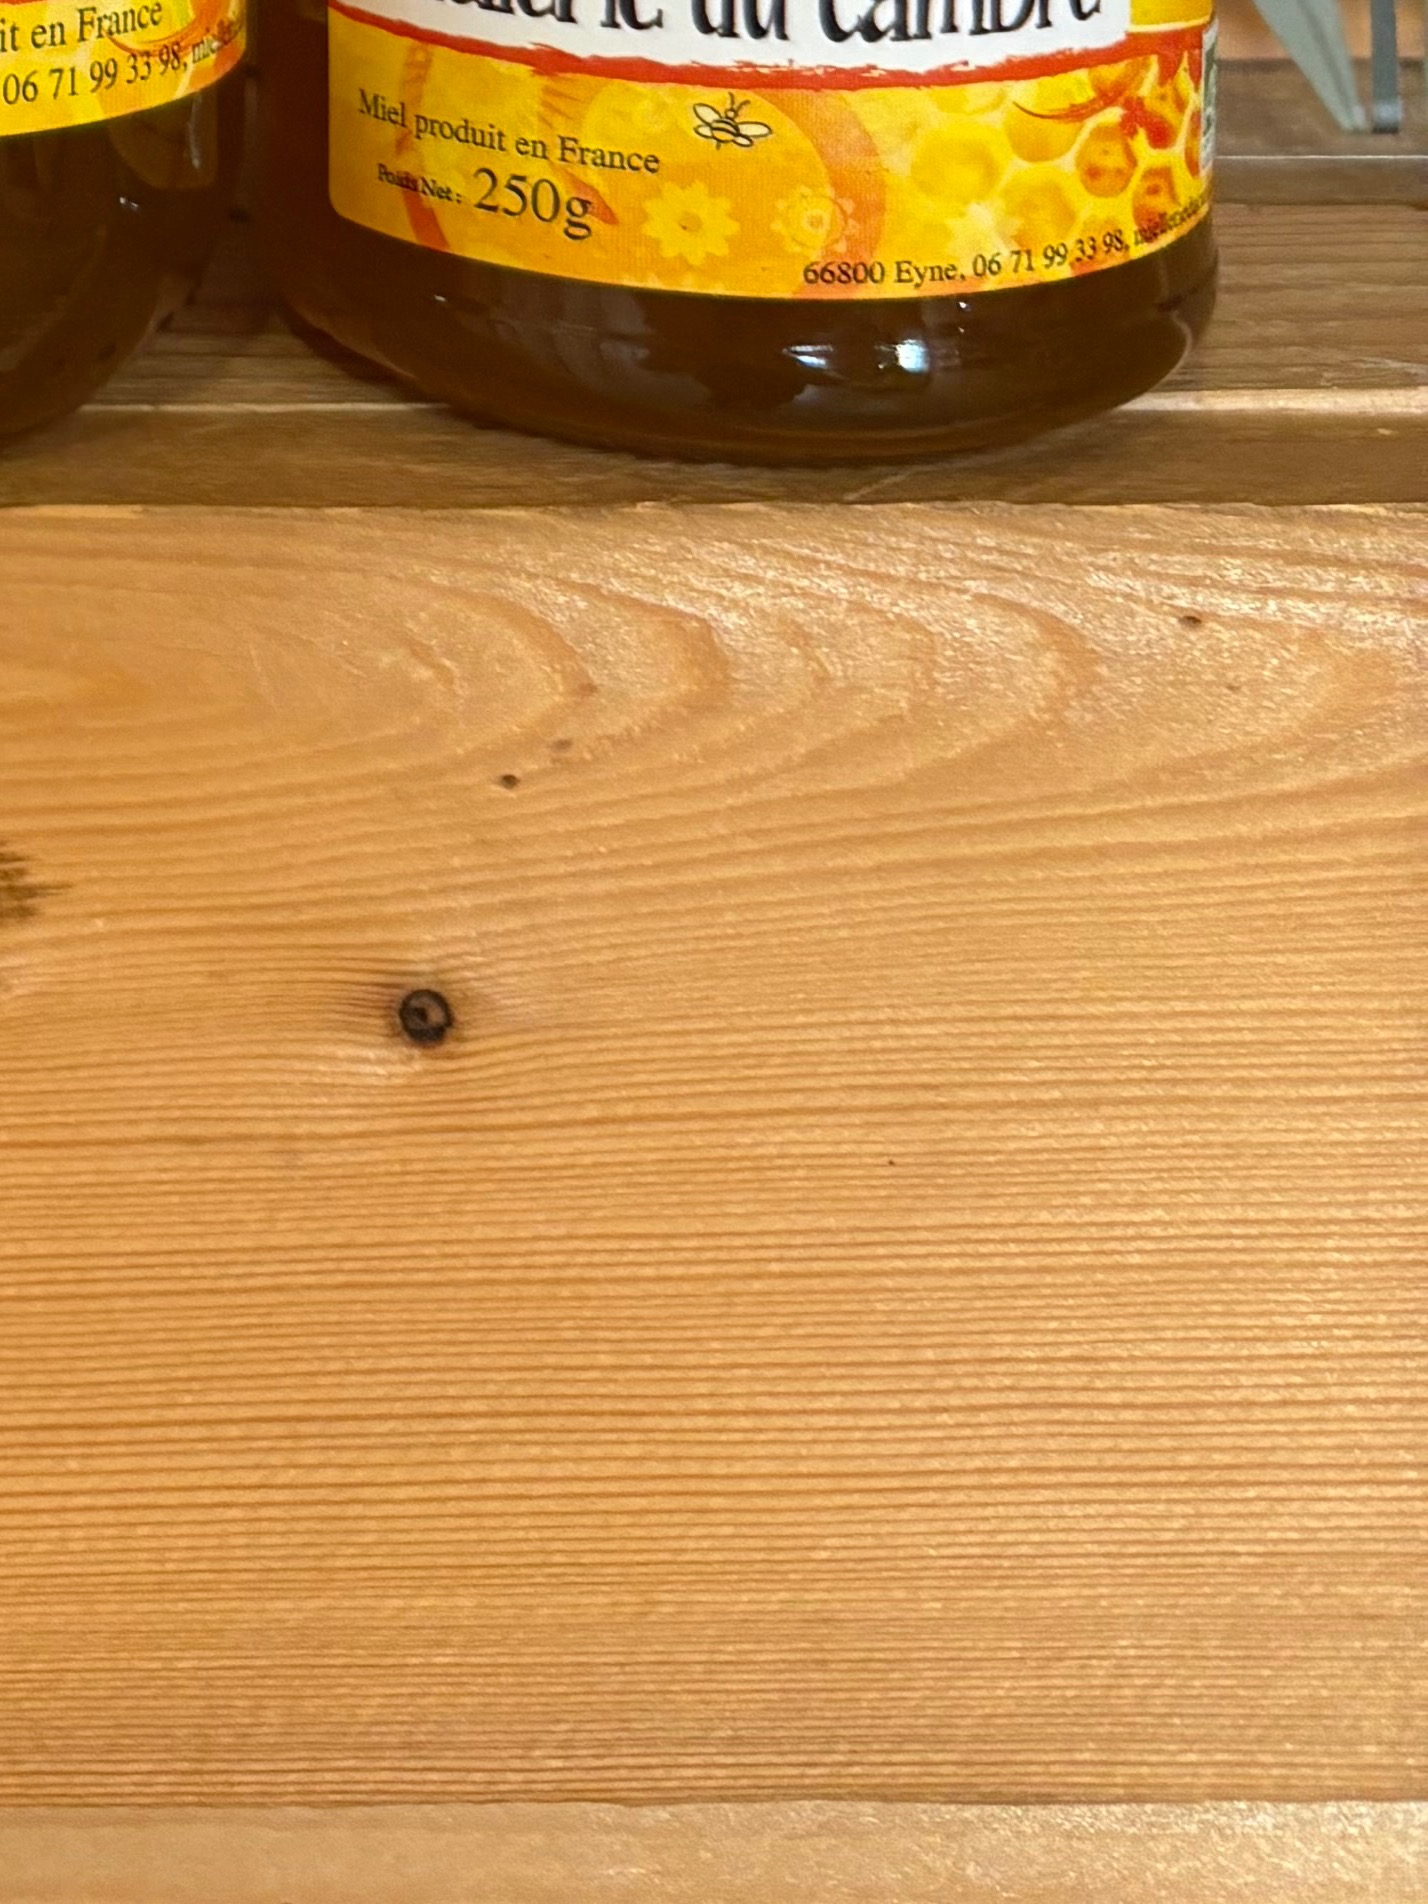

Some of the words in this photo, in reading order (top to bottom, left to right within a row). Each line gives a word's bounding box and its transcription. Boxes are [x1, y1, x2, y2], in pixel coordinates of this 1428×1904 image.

[30, 16, 66, 48] en
[77, 1, 163, 43] France
[2, 72, 39, 106] 06
[48, 65, 79, 100] 71
[89, 57, 118, 94] 99
[125, 50, 152, 85] 33
[158, 40, 188, 77] 98,
[358, 88, 408, 128] Miel
[415, 108, 507, 153] produit
[515, 134, 548, 161] en
[558, 134, 661, 175] France
[473, 166, 593, 241] 250g
[803, 259, 886, 286] 66800
[894, 258, 966, 289] Eyne,
[972, 252, 1003, 277] 06
[1010, 247, 1036, 273] 71
[1042, 242, 1068, 270] 99
[1075, 236, 1098, 262] 33
